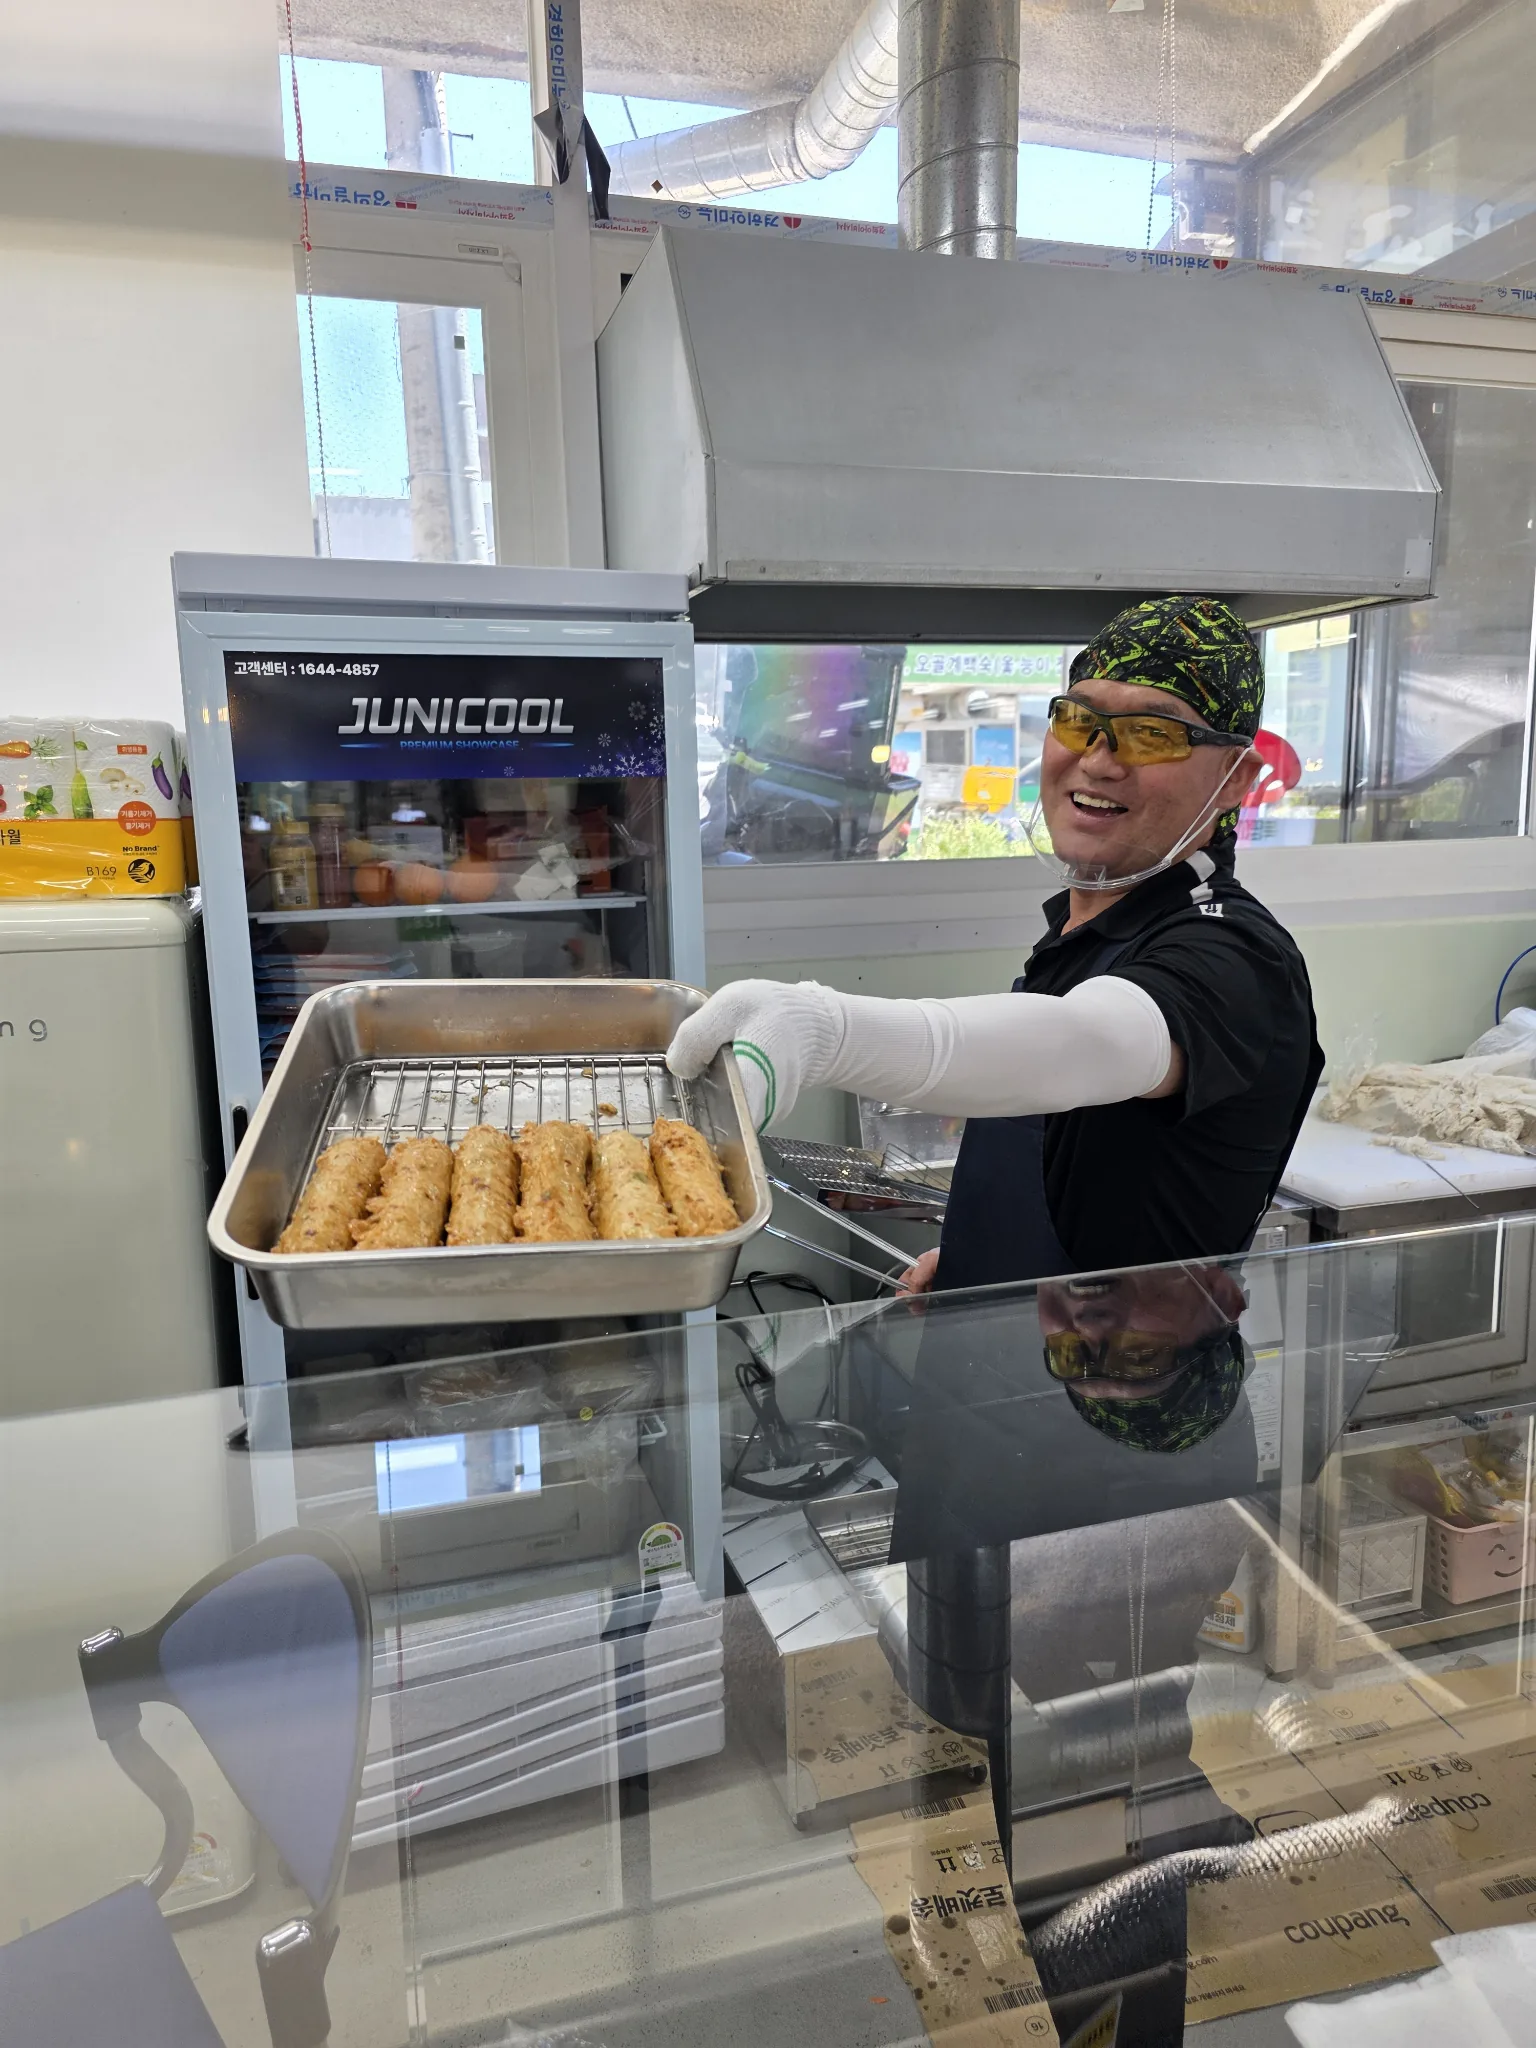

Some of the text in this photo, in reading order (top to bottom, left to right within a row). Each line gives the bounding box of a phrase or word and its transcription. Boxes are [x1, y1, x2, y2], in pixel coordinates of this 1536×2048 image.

[234, 661, 288, 677] 고객센터
[296, 662, 380, 677] 1644-4857
[337, 697, 575, 735] JUNICOOL
[400, 740, 520, 751] PREMIUM SHOWCASE
[134, 845, 158, 853] Brand
[86, 866, 117, 877] B169
[910, 1884, 1007, 1920] 로켓배송
[1283, 1904, 1410, 1946] coupang
[1030, 2021, 1044, 2031] 16
